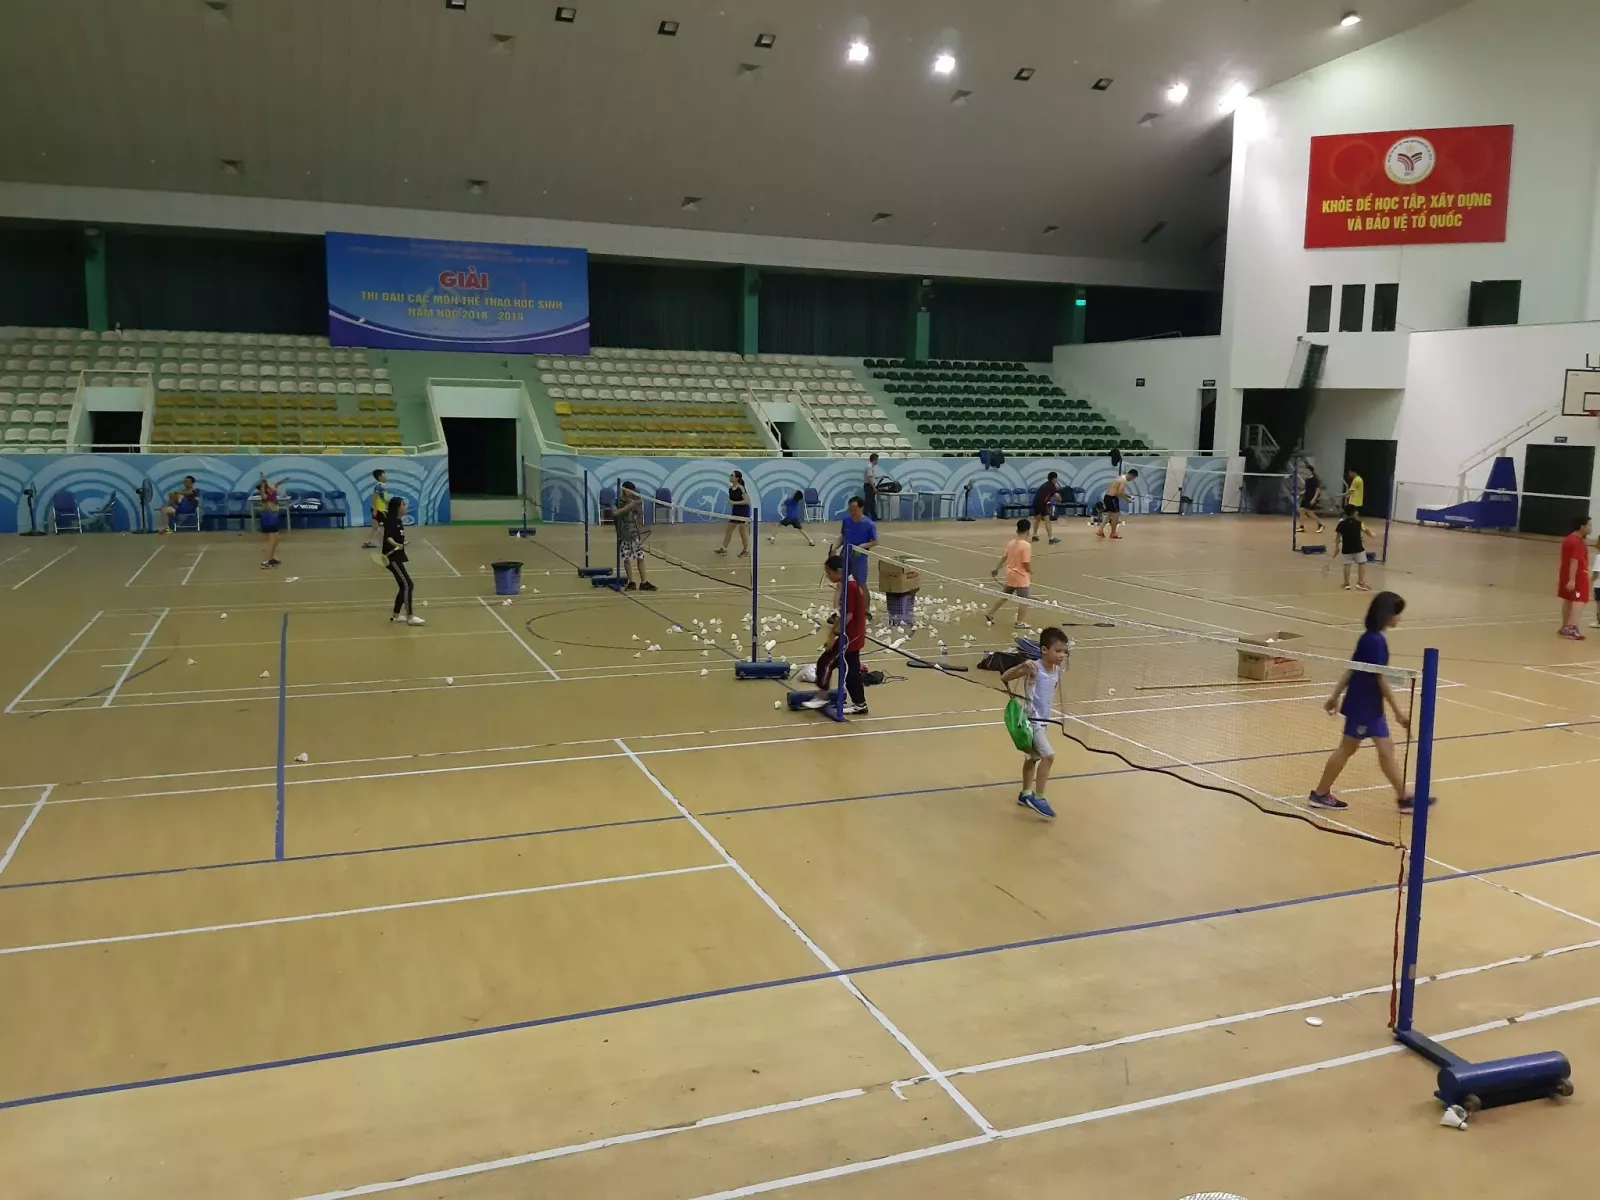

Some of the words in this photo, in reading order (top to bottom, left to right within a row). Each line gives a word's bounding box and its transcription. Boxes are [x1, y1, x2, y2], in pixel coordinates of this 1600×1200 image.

[1322, 195, 1353, 213] KHỎE
[1356, 192, 1373, 212] ĐỂ
[1375, 196, 1400, 213] HỌC
[1430, 192, 1455, 209] XÂY
[1457, 192, 1492, 210] DỰNG
[1347, 215, 1363, 231] VÀ
[1365, 212, 1390, 230] BẢO
[1393, 213, 1408, 232] VỆ
[1429, 209, 1463, 229] QUỐC
[438, 266, 489, 291] GIẢI
[538, 300, 563, 311] SINH
